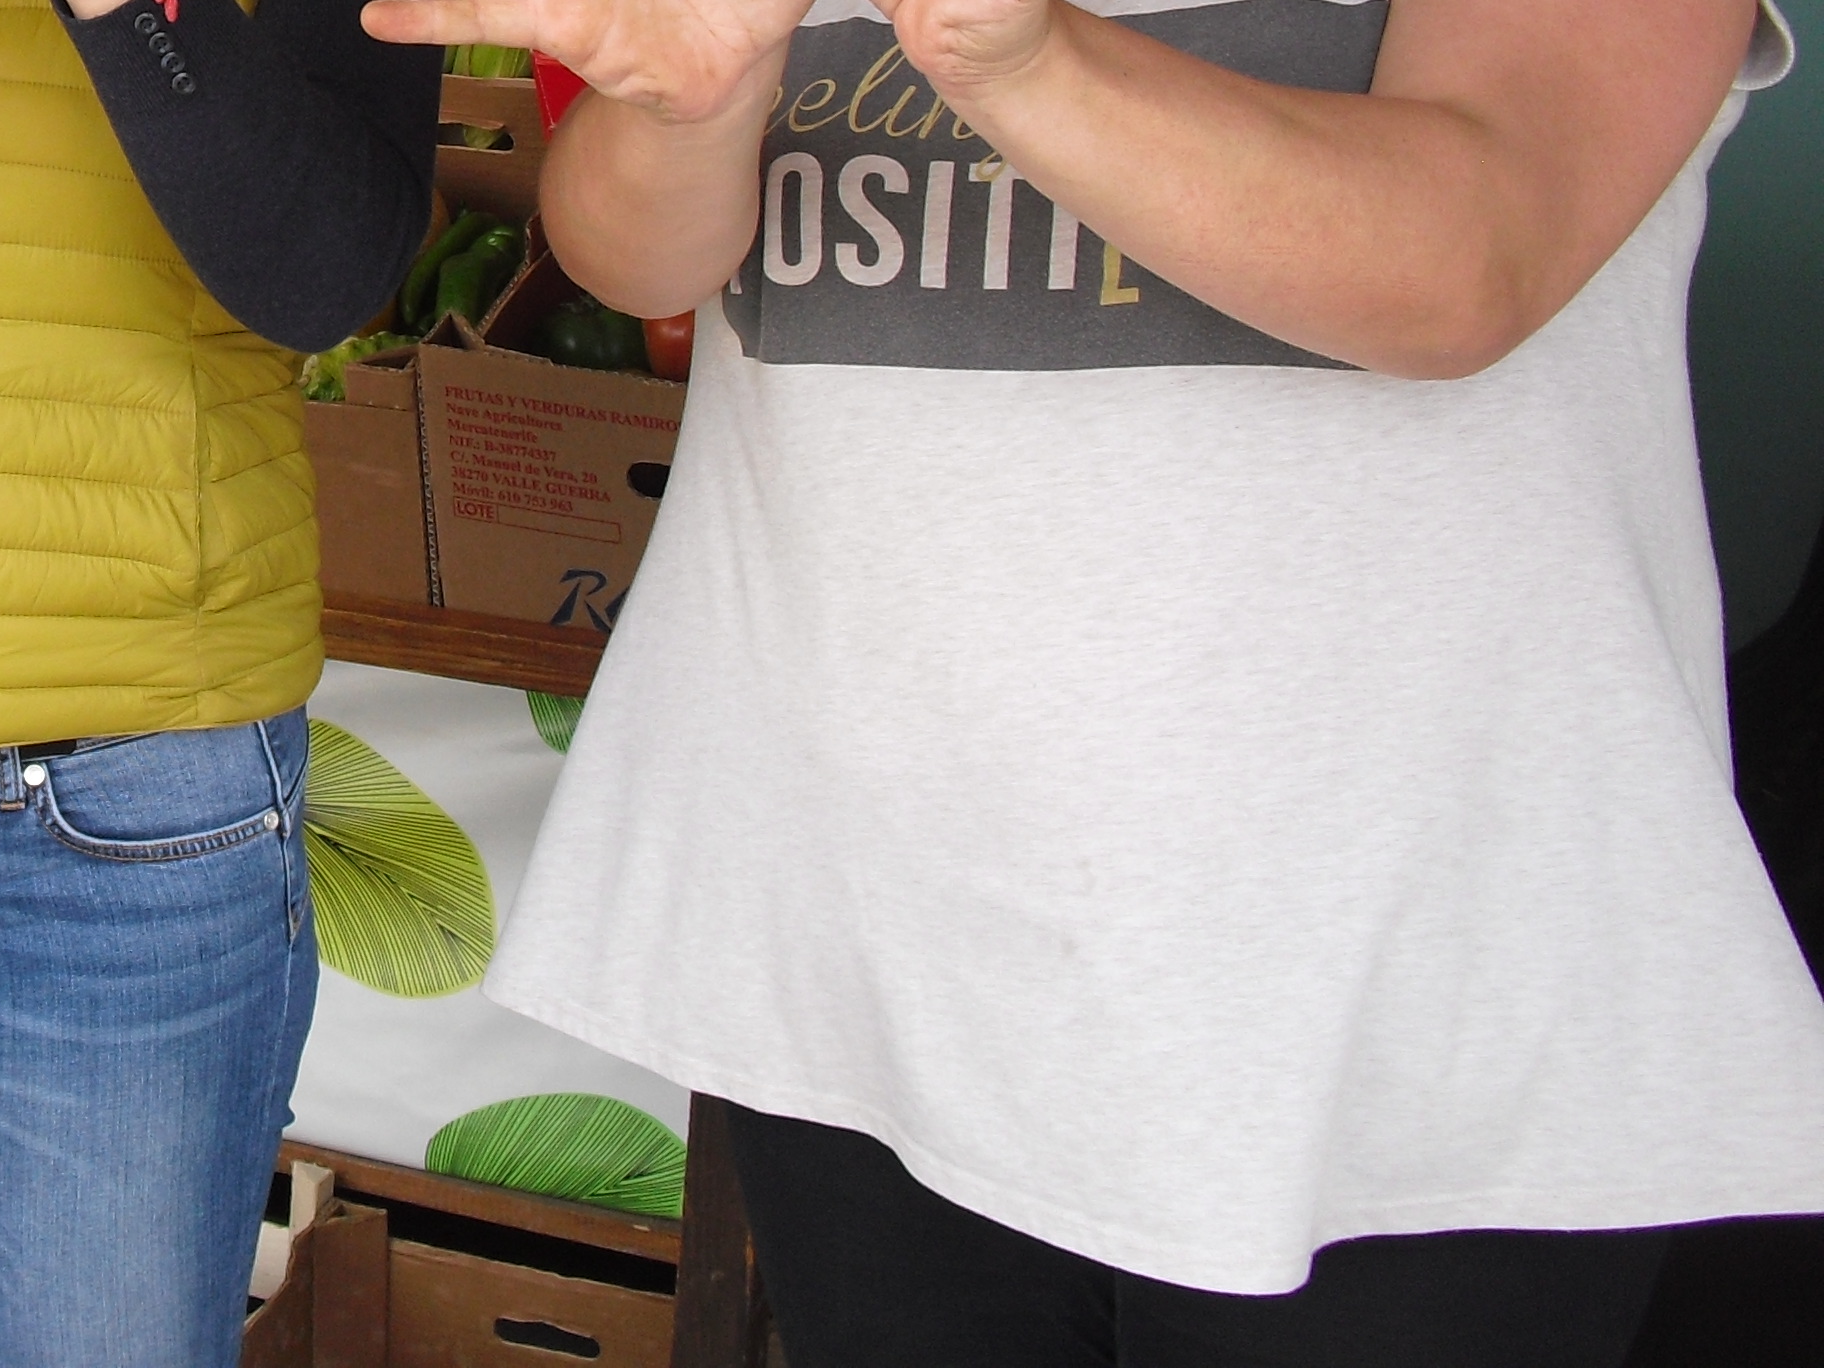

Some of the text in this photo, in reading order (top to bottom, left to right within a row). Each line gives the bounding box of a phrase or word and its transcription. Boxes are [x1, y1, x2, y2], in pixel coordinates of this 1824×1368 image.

[445, 386, 503, 405] FRUTAS
[508, 396, 518, 408] Y
[521, 398, 607, 421] VERDURAS
[446, 403, 563, 432] Nave Agricultores
[447, 419, 538, 443] Mercatenerife
[484, 440, 557, 462] B-38774337
[472, 454, 521, 472] Manuel
[526, 463, 540, 476] de
[544, 467, 578, 483] Vera,
[582, 472, 598, 483] 20
[451, 466, 612, 503] 38270 VALLE GUERRA
[452, 481, 573, 513] Móvil: 610 753 963
[456, 500, 495, 519] LOTE
